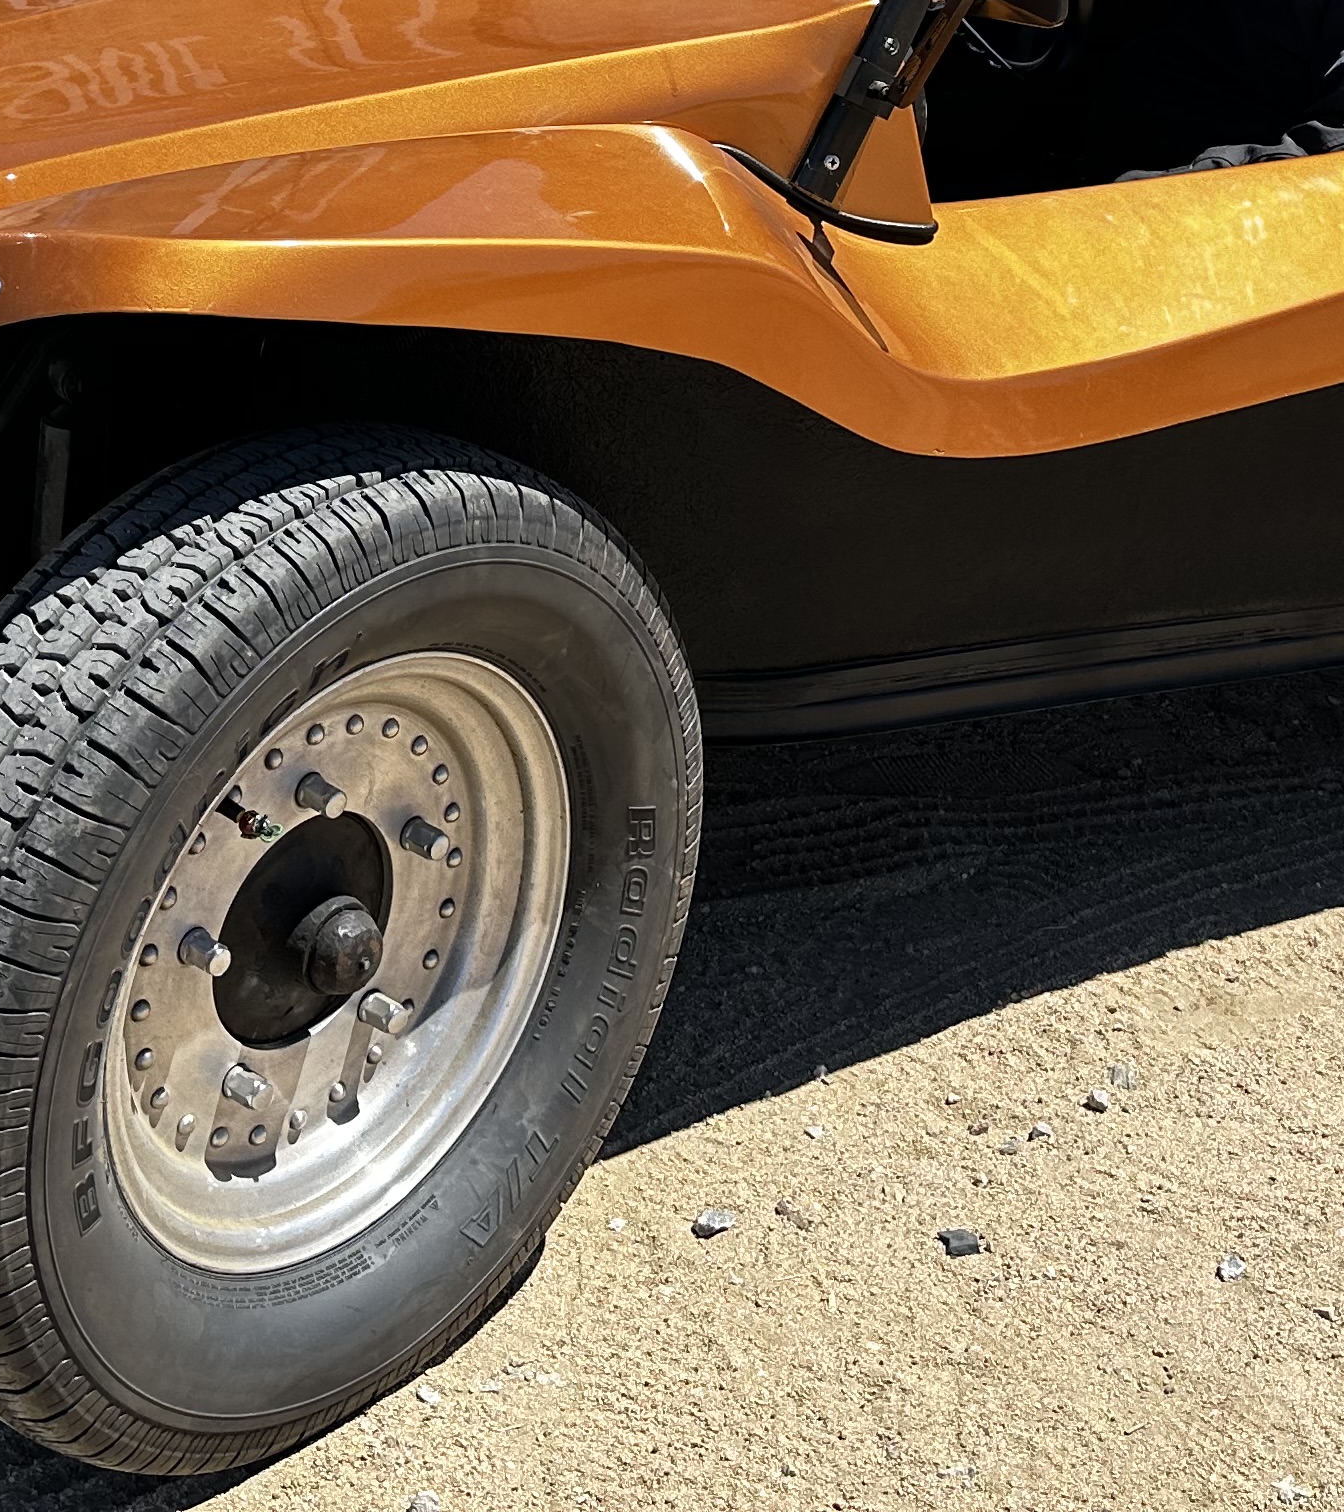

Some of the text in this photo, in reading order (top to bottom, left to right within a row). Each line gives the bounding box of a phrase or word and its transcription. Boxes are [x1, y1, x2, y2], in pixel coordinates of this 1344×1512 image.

[72, 646, 351, 1237] BFGoodrich
[561, 805, 657, 1105] Radial
[460, 1129, 560, 1248] T/A
